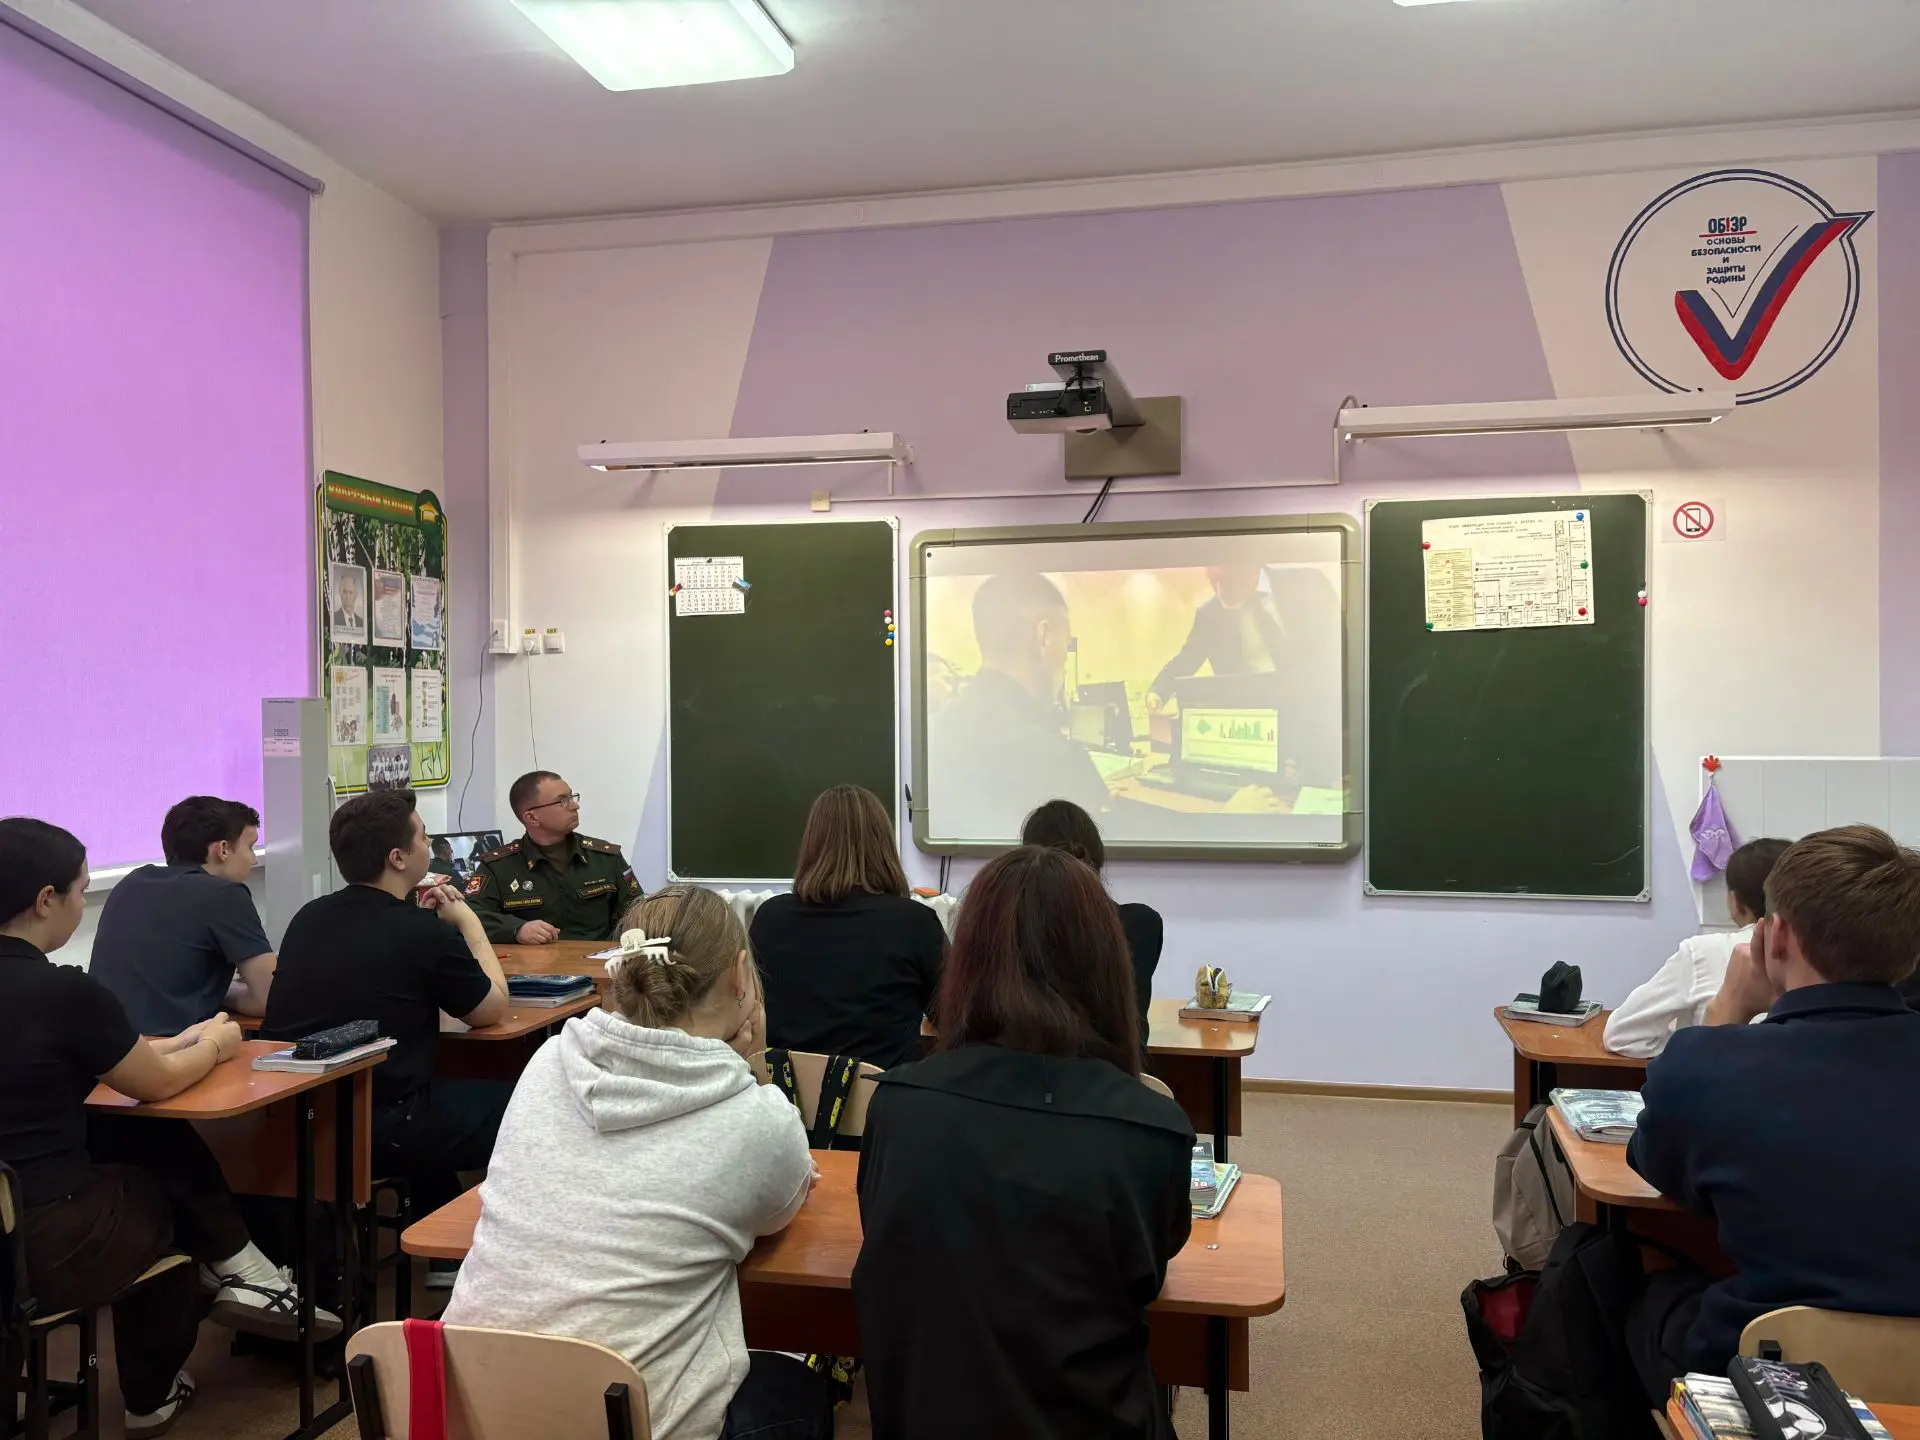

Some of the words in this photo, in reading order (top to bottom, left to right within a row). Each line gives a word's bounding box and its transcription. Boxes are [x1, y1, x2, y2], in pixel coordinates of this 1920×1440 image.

[1706, 236, 1745, 245] ОСНОВЫ
[1691, 245, 1761, 257] БЕЗОПАСНОСТИ
[1722, 256, 1730, 264] И
[1706, 265, 1745, 275] ЗАЩИТЫ
[1706, 274, 1746, 284] РОДИНЫ
[1055, 352, 1099, 363] Promethean
[307, 1108, 314, 1120] 6
[404, 1197, 411, 1207] 5
[88, 1353, 97, 1366] 6
